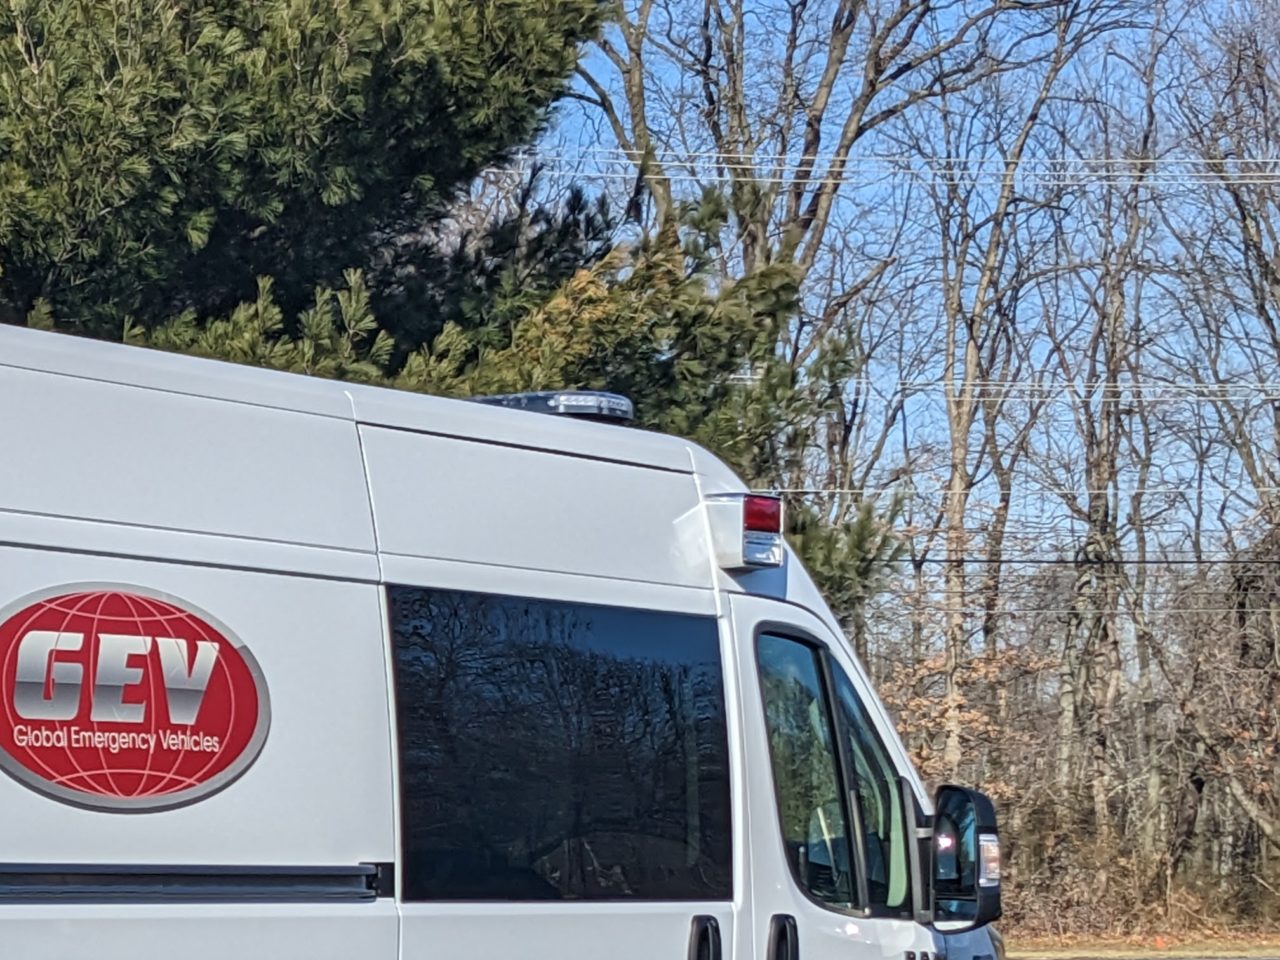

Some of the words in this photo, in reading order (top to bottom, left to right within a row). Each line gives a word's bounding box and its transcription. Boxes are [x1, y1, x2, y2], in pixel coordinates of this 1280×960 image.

[13, 630, 219, 726] GEV
[13, 725, 66, 748] Global
[71, 726, 156, 754] Emergency
[158, 729, 219, 753] Vehicles
